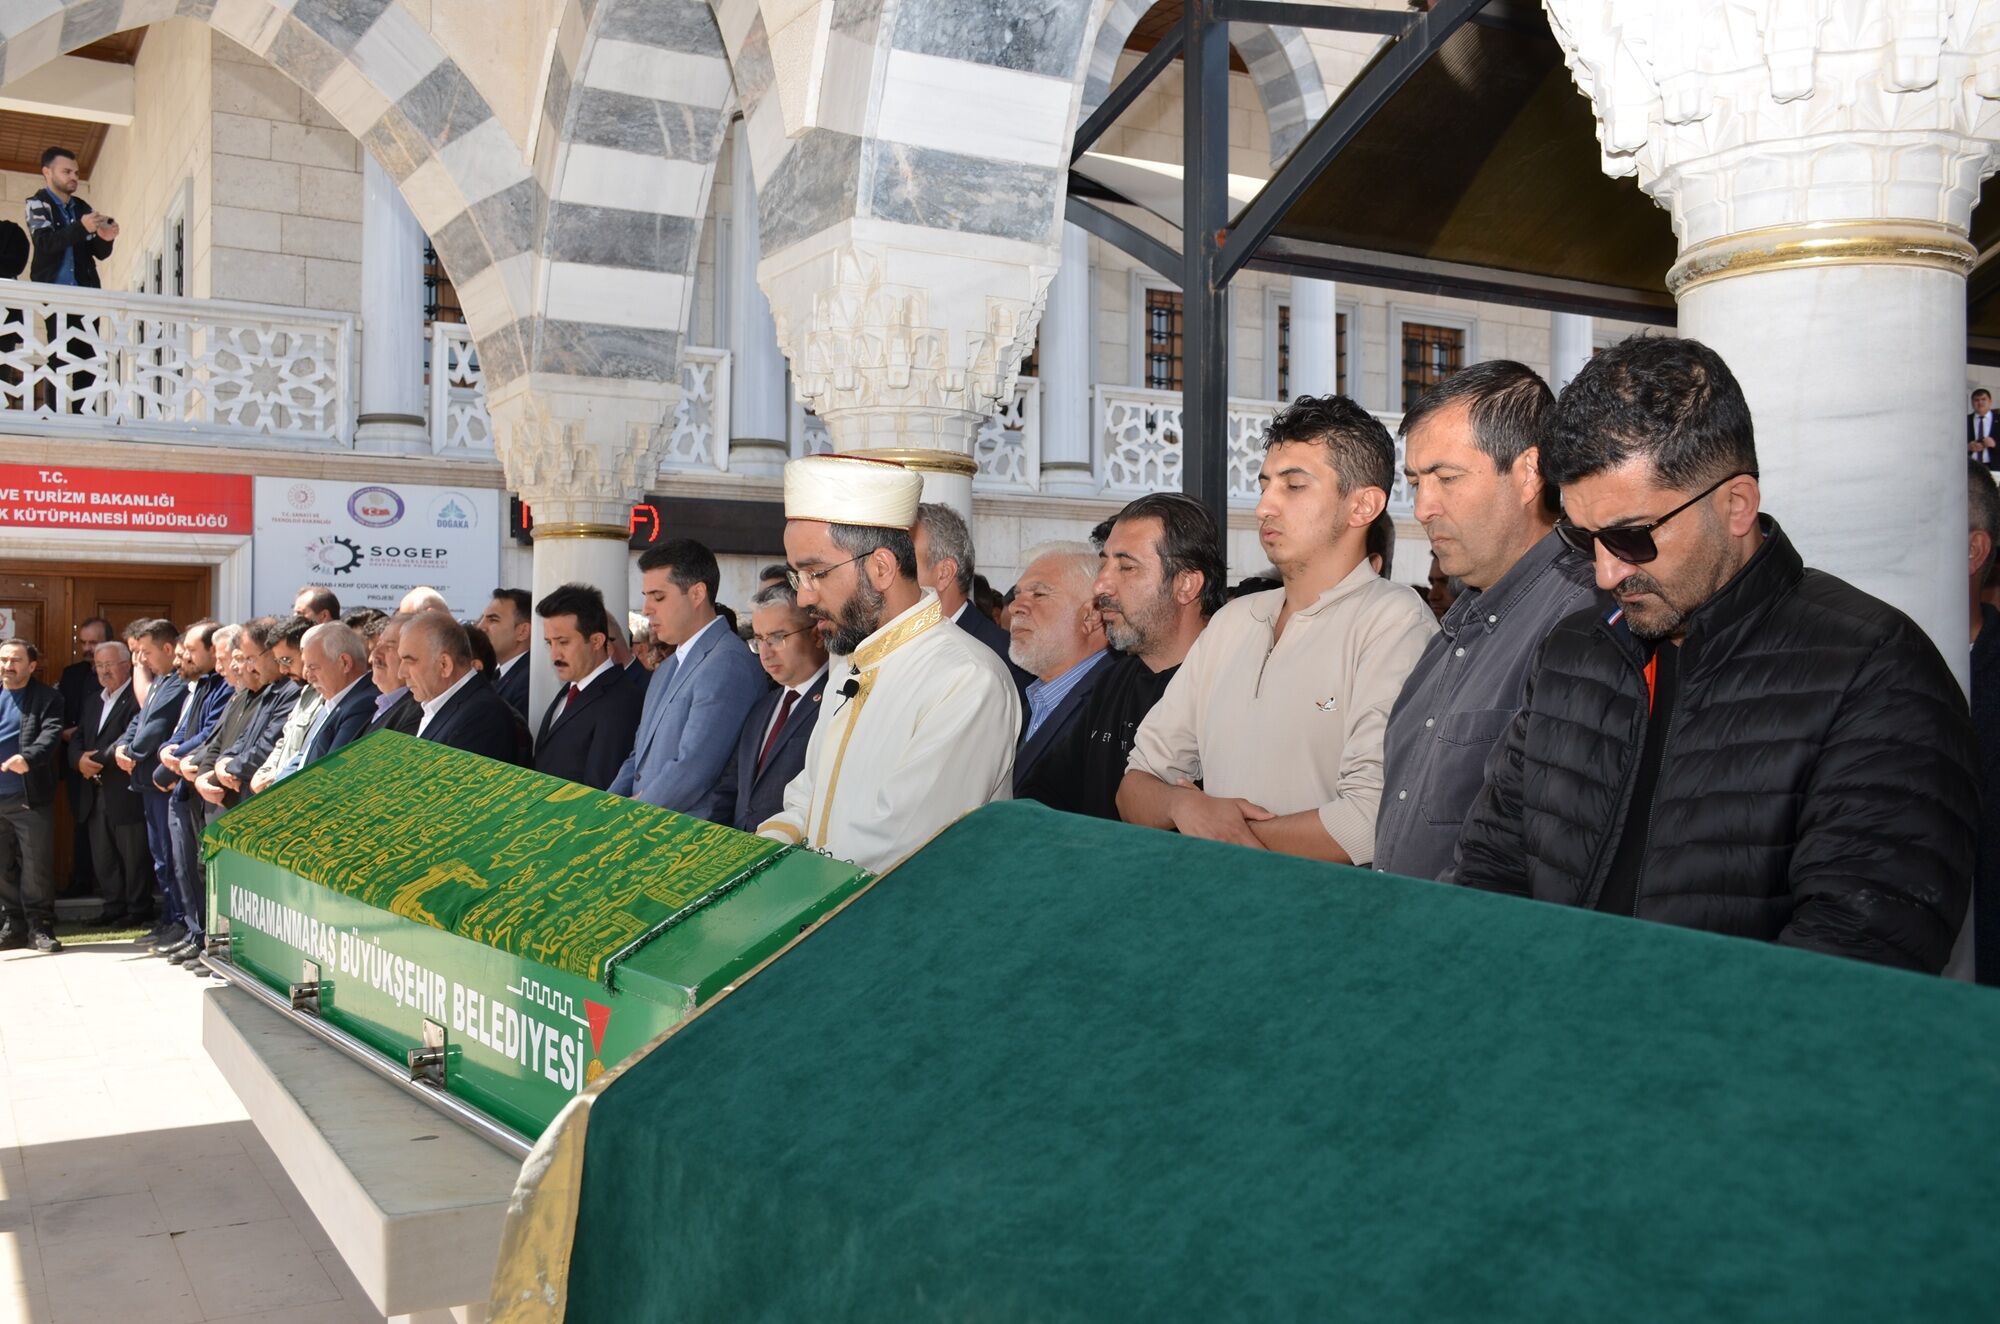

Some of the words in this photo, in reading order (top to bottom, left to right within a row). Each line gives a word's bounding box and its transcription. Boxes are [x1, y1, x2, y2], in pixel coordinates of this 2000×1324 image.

[39, 471, 68, 484] T.C.
[0, 488, 20, 501] VE
[24, 489, 85, 504] TURİZM
[90, 492, 175, 508] BAKANLIĞI
[14, 507, 128, 525] KÜTÜPHANESİ
[132, 512, 228, 527] MÜDÜRLÜĞÜ
[437, 519, 469, 529] DOĞAKA
[370, 546, 448, 559] SOGEP
[230, 883, 337, 974] KAHRAMANMARAŞ
